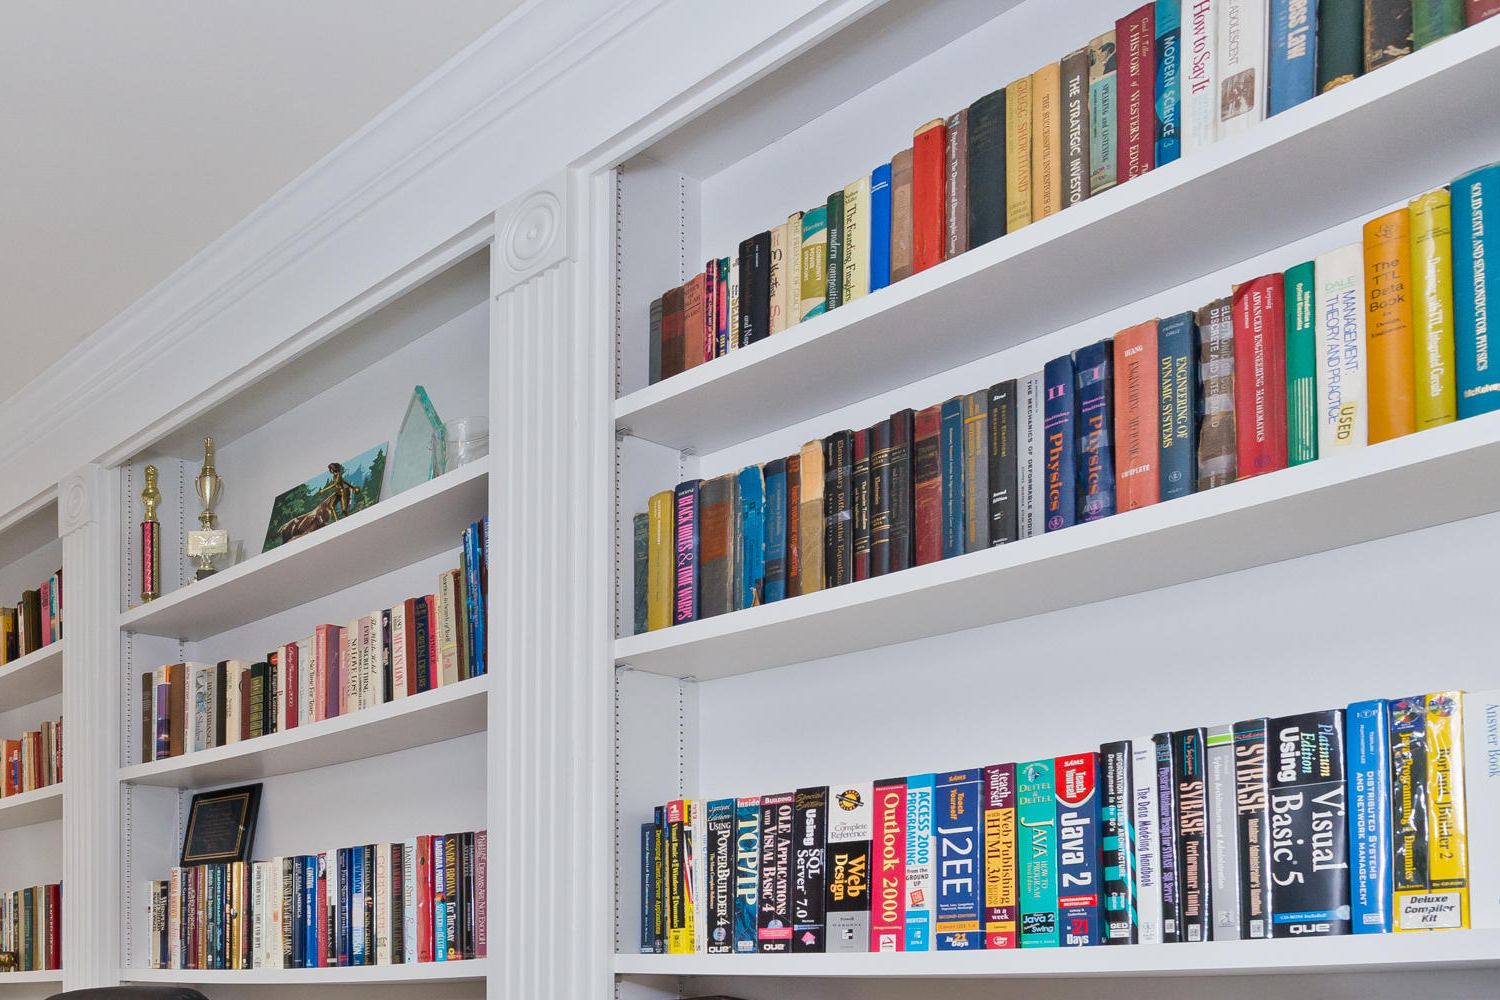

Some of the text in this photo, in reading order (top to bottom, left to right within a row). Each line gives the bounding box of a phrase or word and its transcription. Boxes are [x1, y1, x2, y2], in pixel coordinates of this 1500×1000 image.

[1188, 0, 1211, 94] How to Say It
[1286, 25, 1310, 61] Law
[1162, 36, 1175, 148] MODERN SCIENCE 3
[1069, 75, 1082, 206] THE STRATEGIC INVESTO
[847, 204, 857, 222] The
[845, 224, 857, 260] Founding
[1325, 275, 1356, 292] DALE
[1372, 258, 1399, 273] The
[1372, 270, 1401, 286] TTL
[1369, 295, 1405, 313] Book
[1371, 282, 1404, 300] Data
[1252, 291, 1265, 443] ADVANCED ENGINEERING MATHEMATICS
[1325, 295, 1342, 424] THEORY AND PRACTICE
[1161, 356, 1173, 449] DYNAMIC SYSTEMS
[1176, 356, 1188, 439] ENGINEERING OF
[1337, 406, 1355, 441] USED
[1047, 432, 1063, 512] Physics
[1088, 414, 1102, 495] Physics
[1063, 759, 1084, 768] SAMS
[1276, 726, 1301, 783] Using
[1300, 732, 1316, 775] Edition
[1317, 723, 1334, 778] Platinum
[988, 768, 1003, 808] yourself
[1000, 772, 1012, 798] teach
[1019, 782, 1053, 794] DEITEL
[1019, 795, 1053, 806] DEITEL
[1075, 770, 1087, 795] Teach
[1235, 743, 1266, 817] SYBASE
[736, 799, 760, 808] Inside
[778, 804, 792, 834] OLE
[950, 789, 958, 820] Yourself
[957, 793, 965, 815] Teach
[1179, 781, 1205, 837] SYBASE
[803, 808, 817, 846] Using
[906, 792, 917, 866] PROGRAMMING
[916, 791, 930, 865] ACCESS 2000
[1020, 817, 1055, 859] JAVA
[1271, 791, 1305, 887] Basic 5
[1310, 784, 1348, 873] Visual
[1355, 773, 1369, 907] AND NETWORK MANAGEMENT
[1366, 771, 1378, 881] DISTRIBUTED SYSTEMS
[405, 845, 413, 882] DANIELLE
[445, 838, 455, 896] SANDRA BROWN
[736, 813, 759, 906] TCP/IP
[808, 849, 820, 879] SQL
[881, 792, 901, 922] Outlook 2000
[937, 826, 974, 897] J2EE
[1001, 810, 1013, 904] Web Publishing
[1060, 811, 1092, 888] Java 2
[775, 837, 791, 916] APPLICATIONS
[797, 850, 809, 919] Server 7.0
[830, 853, 849, 902] Design
[847, 853, 868, 898] Web
[905, 874, 929, 885] GROUND
[1404, 904, 1456, 916] Compiler
[1410, 894, 1449, 905] Deluxe
[1421, 913, 1438, 924] Kit
[447, 901, 458, 942] FAT TUESDAY
[1066, 932, 1089, 947] Days
